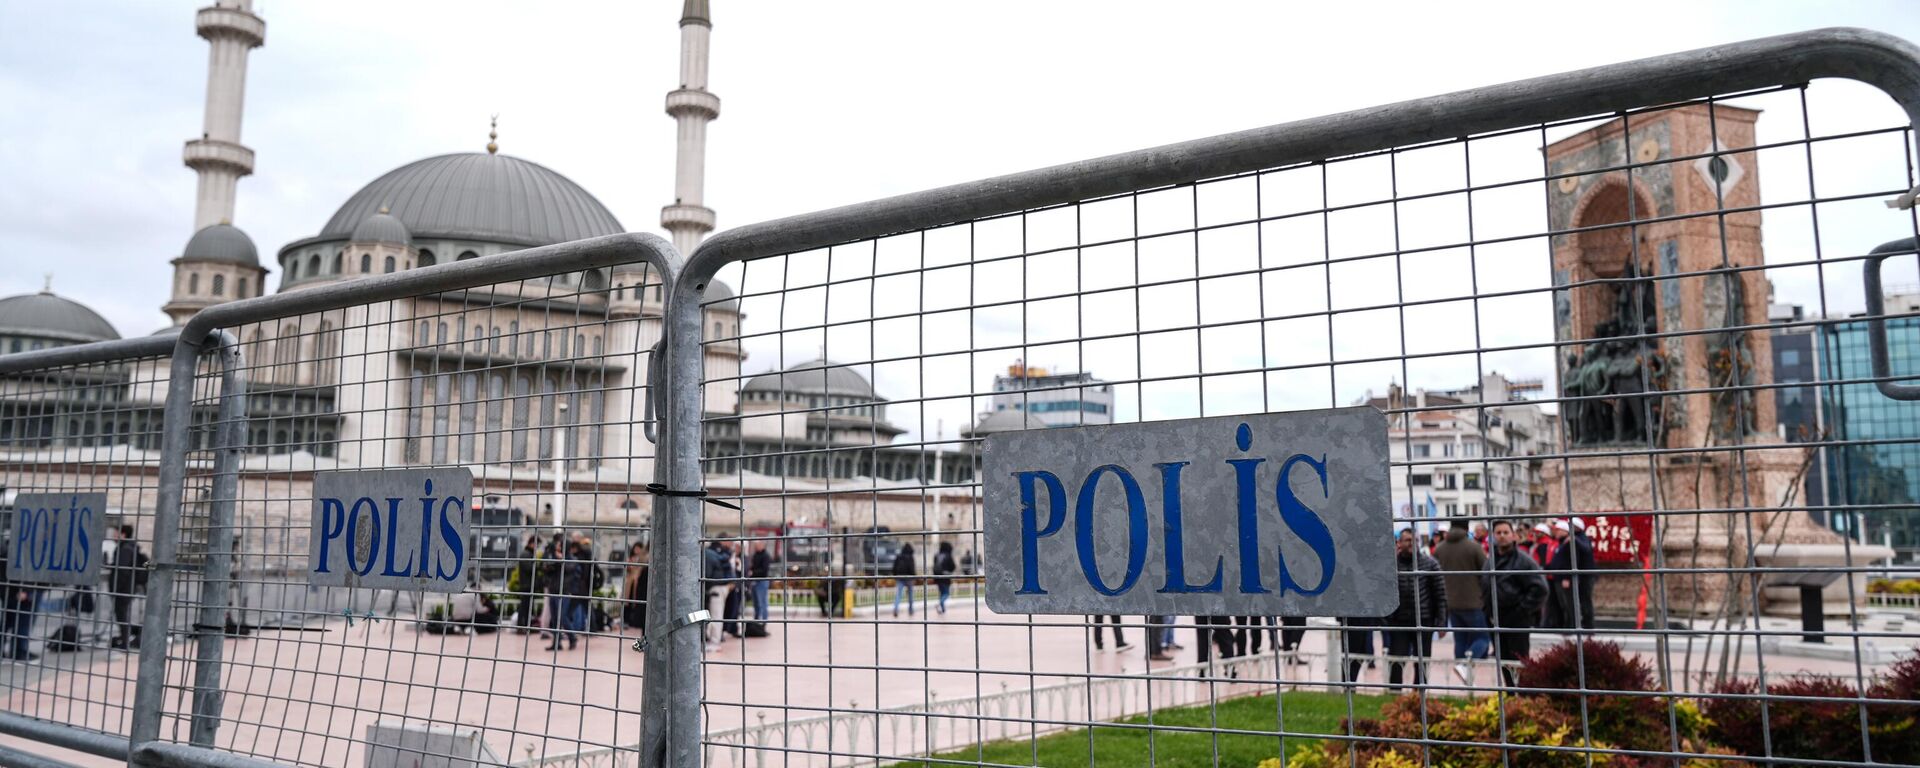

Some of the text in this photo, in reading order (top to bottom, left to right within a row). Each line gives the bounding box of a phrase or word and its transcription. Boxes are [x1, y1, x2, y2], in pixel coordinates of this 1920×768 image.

[14, 495, 92, 573] POLİS
[314, 478, 465, 582] POLİS
[1011, 422, 1337, 598] POLİS
